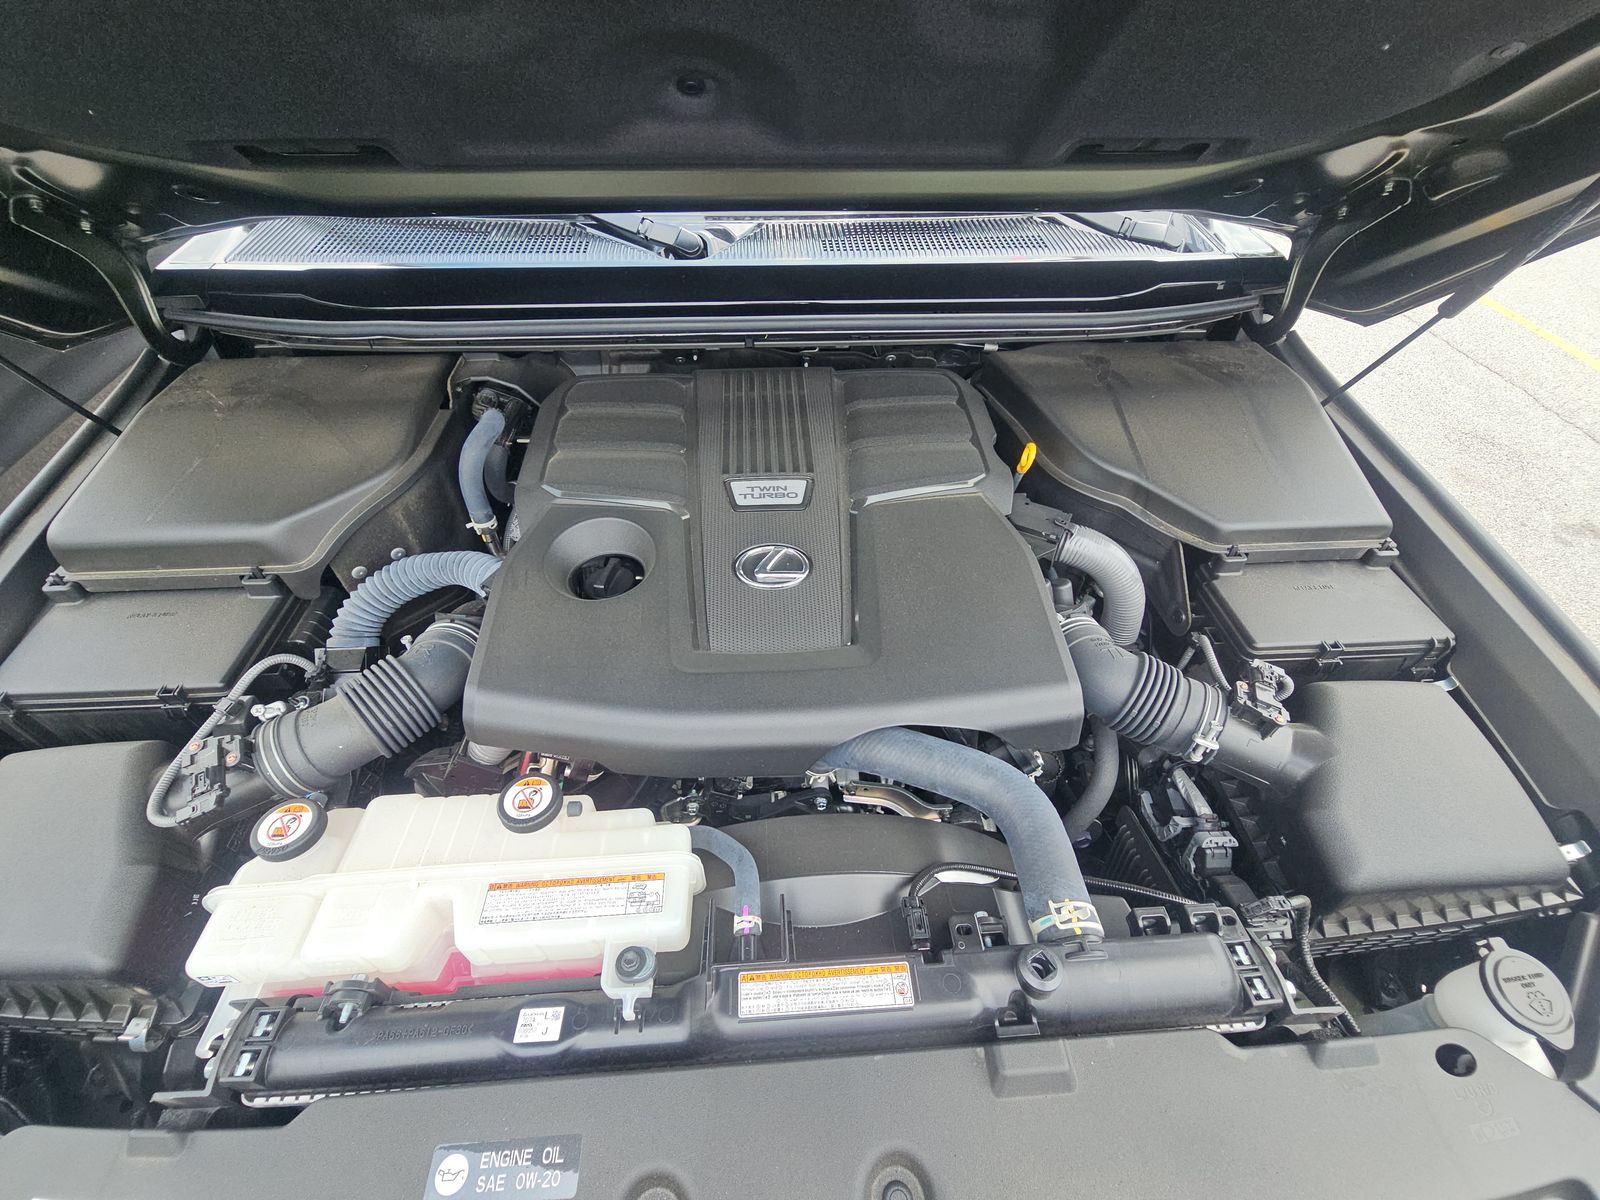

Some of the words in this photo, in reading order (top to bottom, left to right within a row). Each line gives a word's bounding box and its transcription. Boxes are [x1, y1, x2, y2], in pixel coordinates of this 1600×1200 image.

[738, 491, 799, 500] TURBO
[479, 1148, 534, 1169] ENGINE
[542, 1145, 564, 1164] OIL
[475, 1173, 507, 1193] SAE
[515, 1170, 561, 1189] 0W-20
